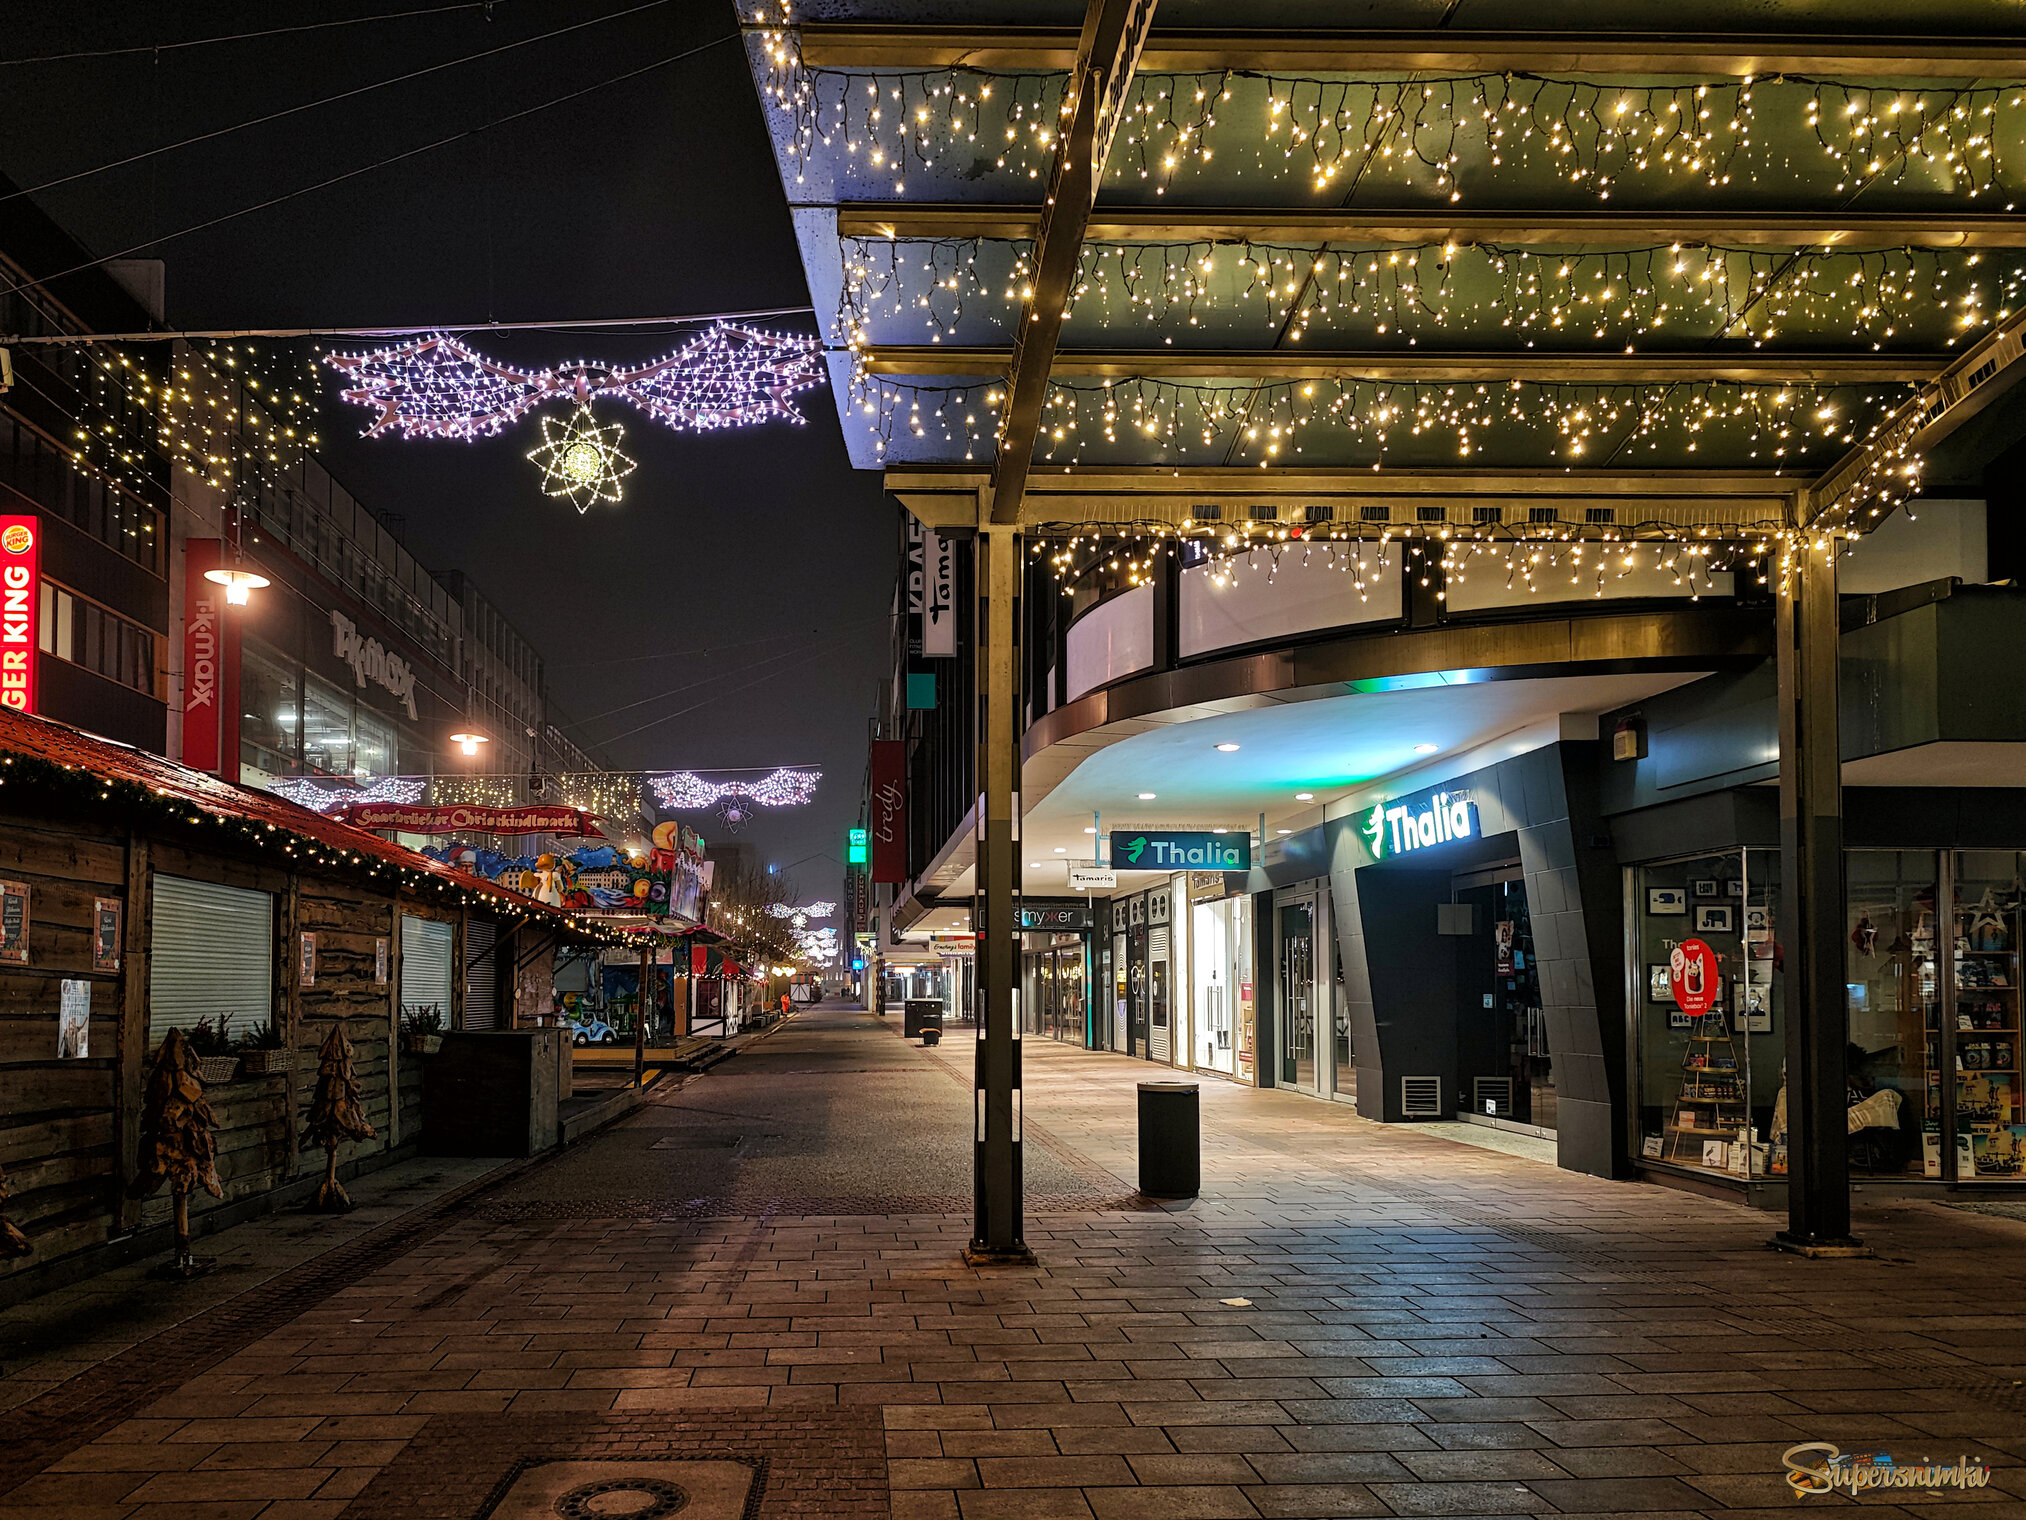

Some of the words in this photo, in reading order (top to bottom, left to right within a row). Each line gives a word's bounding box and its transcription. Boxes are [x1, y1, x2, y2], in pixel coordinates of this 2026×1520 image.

[6, 530, 28, 541] BURGER
[6, 535, 29, 548] KING
[3, 566, 30, 643] KING
[355, 808, 448, 827] Saarbrücker
[450, 808, 579, 828] Christkindlmarkt
[875, 779, 904, 843] tredy
[1385, 791, 1471, 854] Thalia
[1151, 841, 1240, 865] Thalia
[1072, 873, 1114, 883] Tamaris
